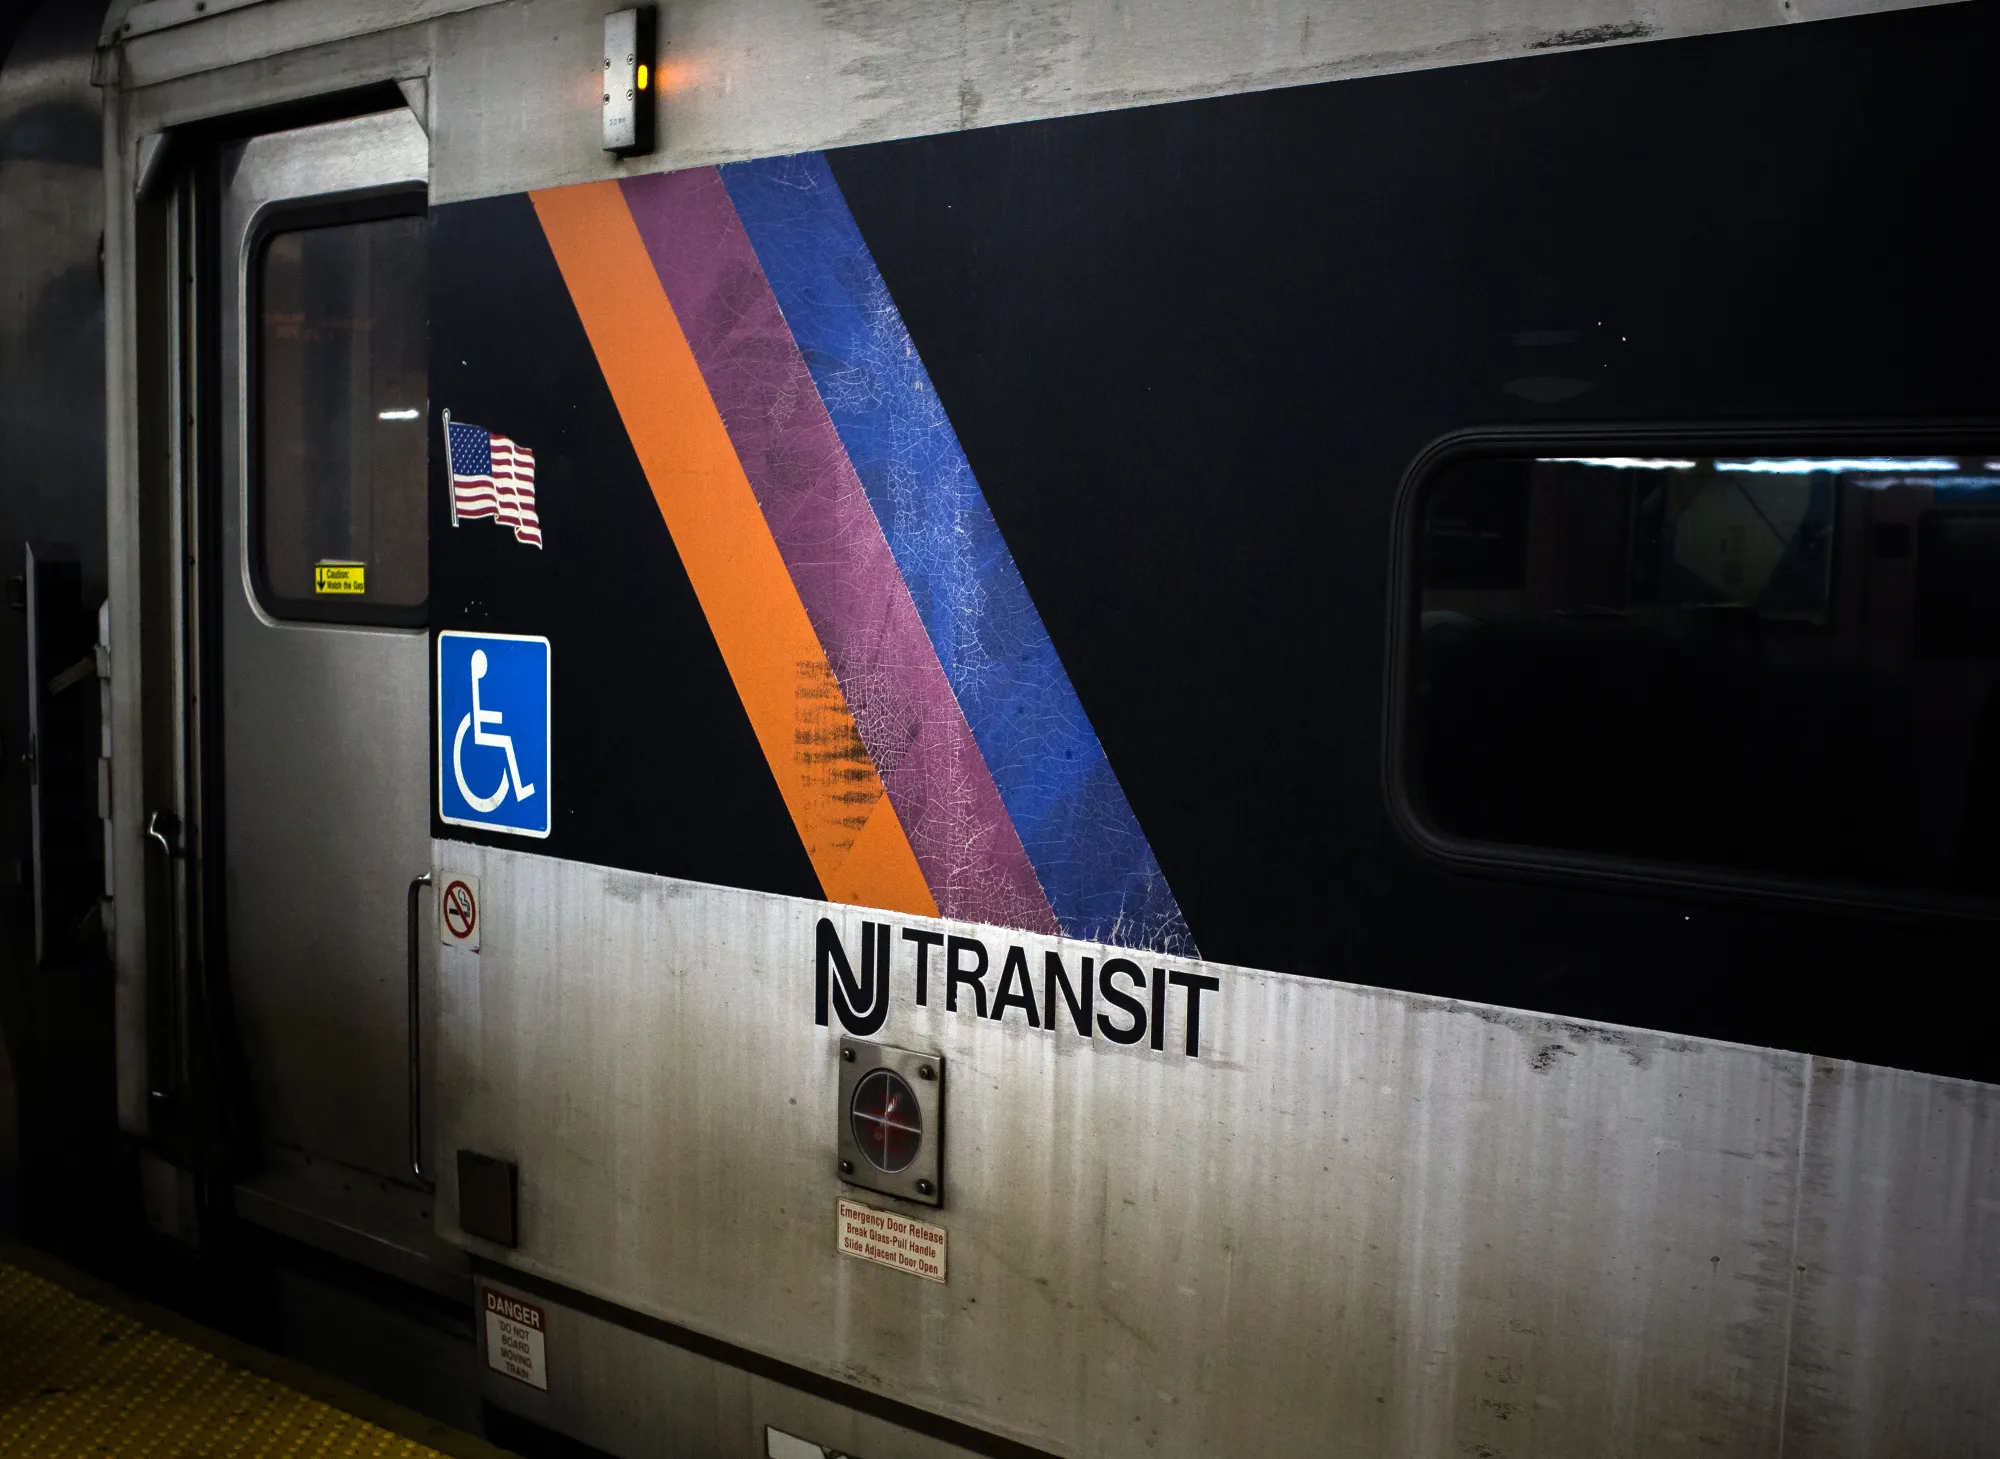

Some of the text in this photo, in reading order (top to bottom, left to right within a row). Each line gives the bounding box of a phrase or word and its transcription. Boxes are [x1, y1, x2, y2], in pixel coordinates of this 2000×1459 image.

[815, 917, 1220, 1058] NJ TRANSIT
[840, 1204, 944, 1245] Emergency Door Release
[846, 1222, 936, 1258] Break Glass-Pull Handle
[844, 1237, 938, 1275] Slide Adjacent Door Open
[487, 1292, 540, 1328] DANGER
[500, 1320, 530, 1341] DO NOT
[501, 1334, 530, 1354] BOARD
[501, 1346, 532, 1368] MOVING
[505, 1360, 530, 1380] TRAIN
